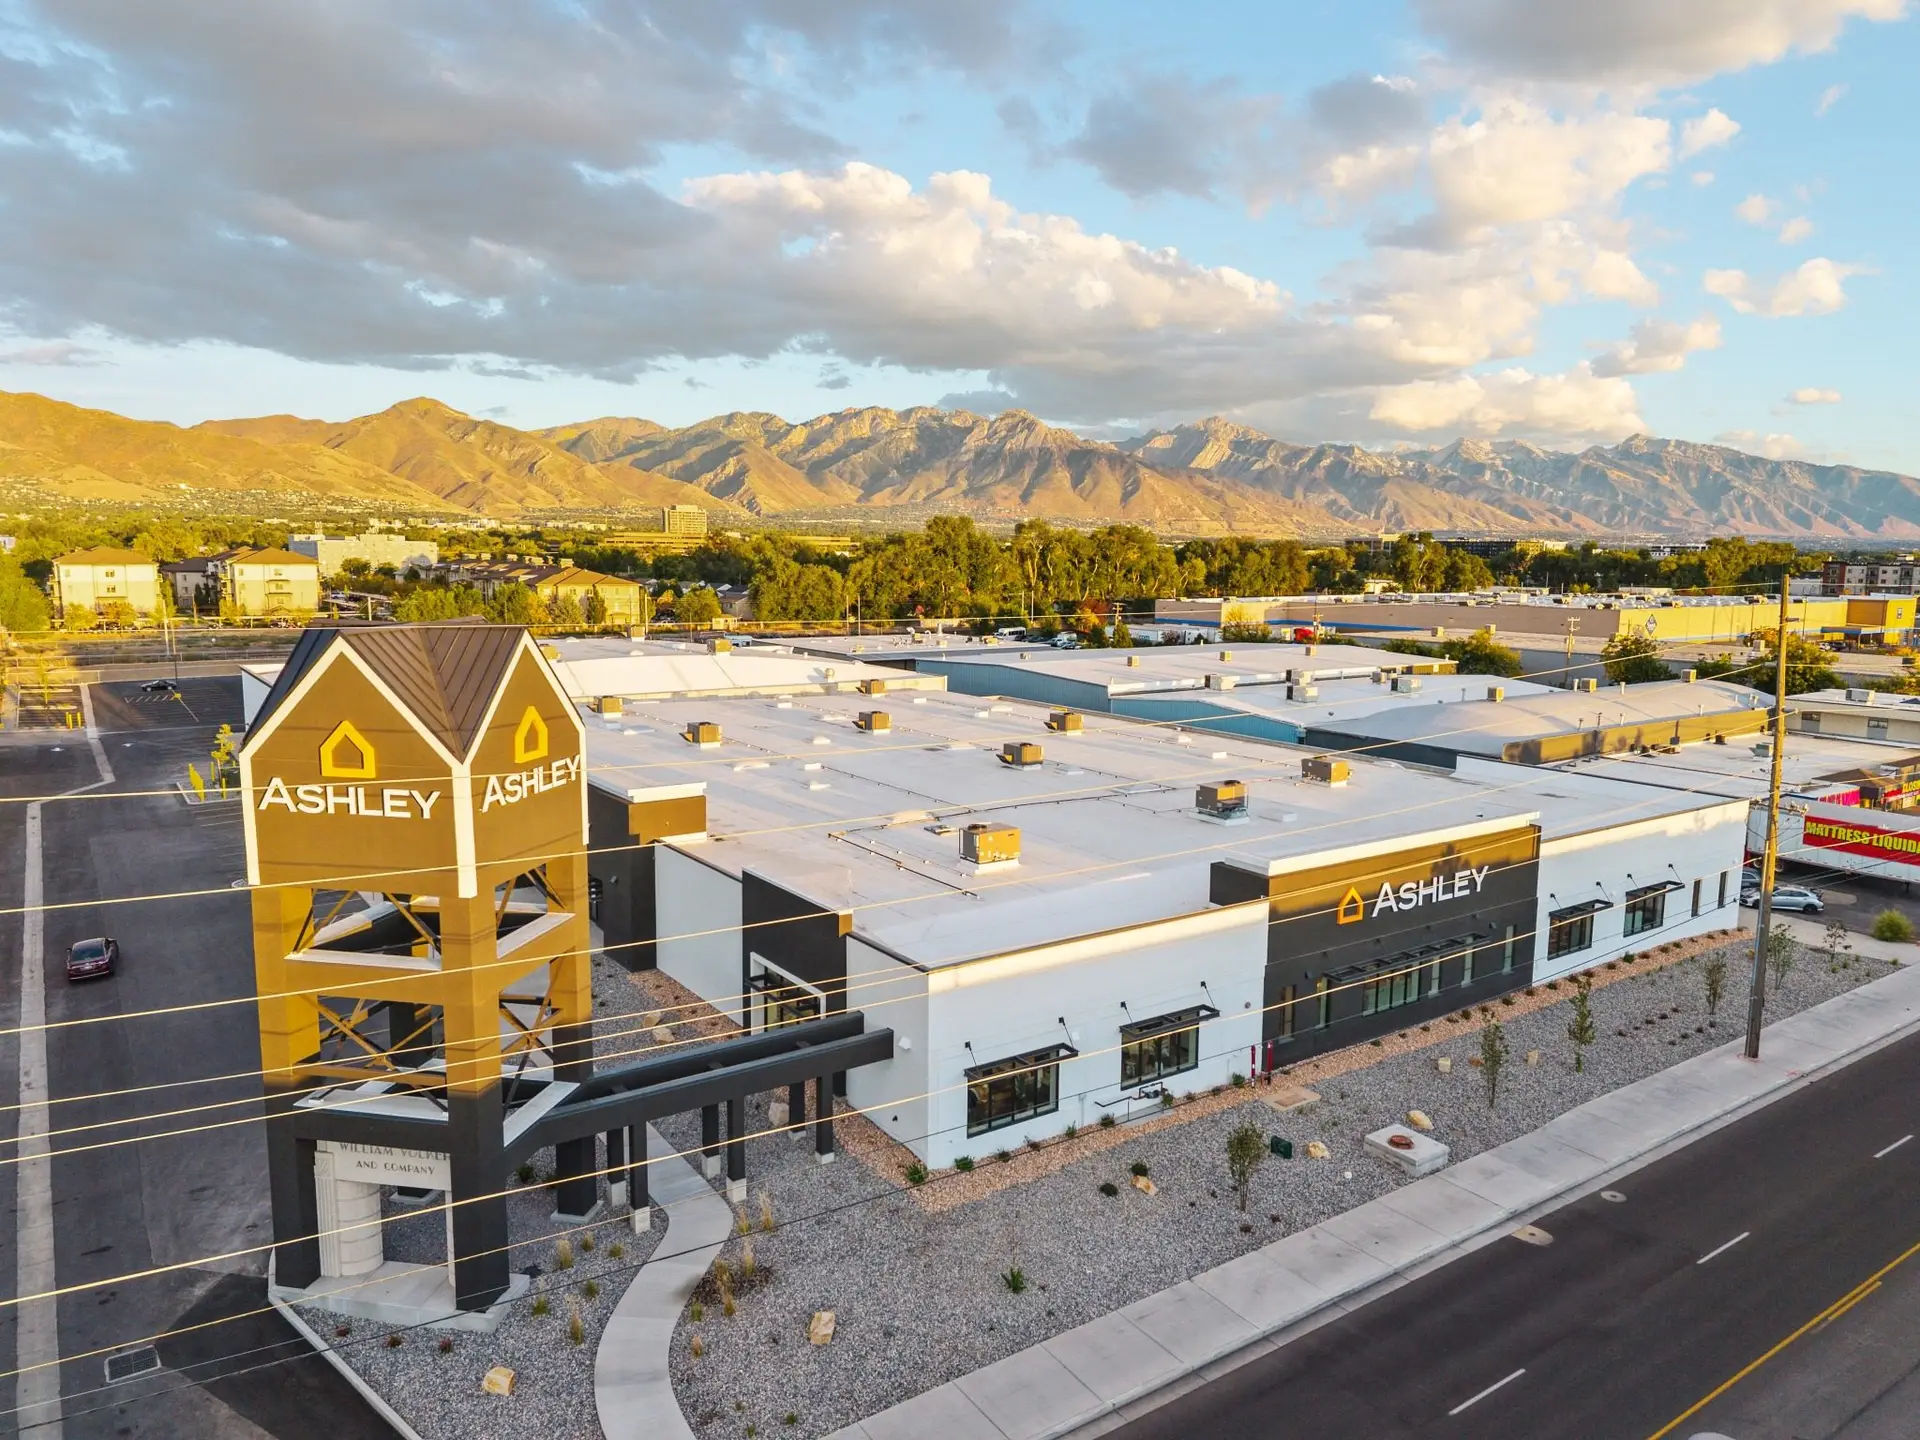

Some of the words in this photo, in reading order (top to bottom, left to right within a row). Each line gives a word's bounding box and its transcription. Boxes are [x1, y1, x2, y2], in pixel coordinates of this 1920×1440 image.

[258, 776, 441, 819] ASHLEY
[481, 754, 581, 813] ASHLEY
[1805, 821, 1871, 845] MATTRESS
[1371, 866, 1489, 917] ASHLEY
[356, 1160, 377, 1169] AND
[383, 1162, 436, 1175] COMPANY
